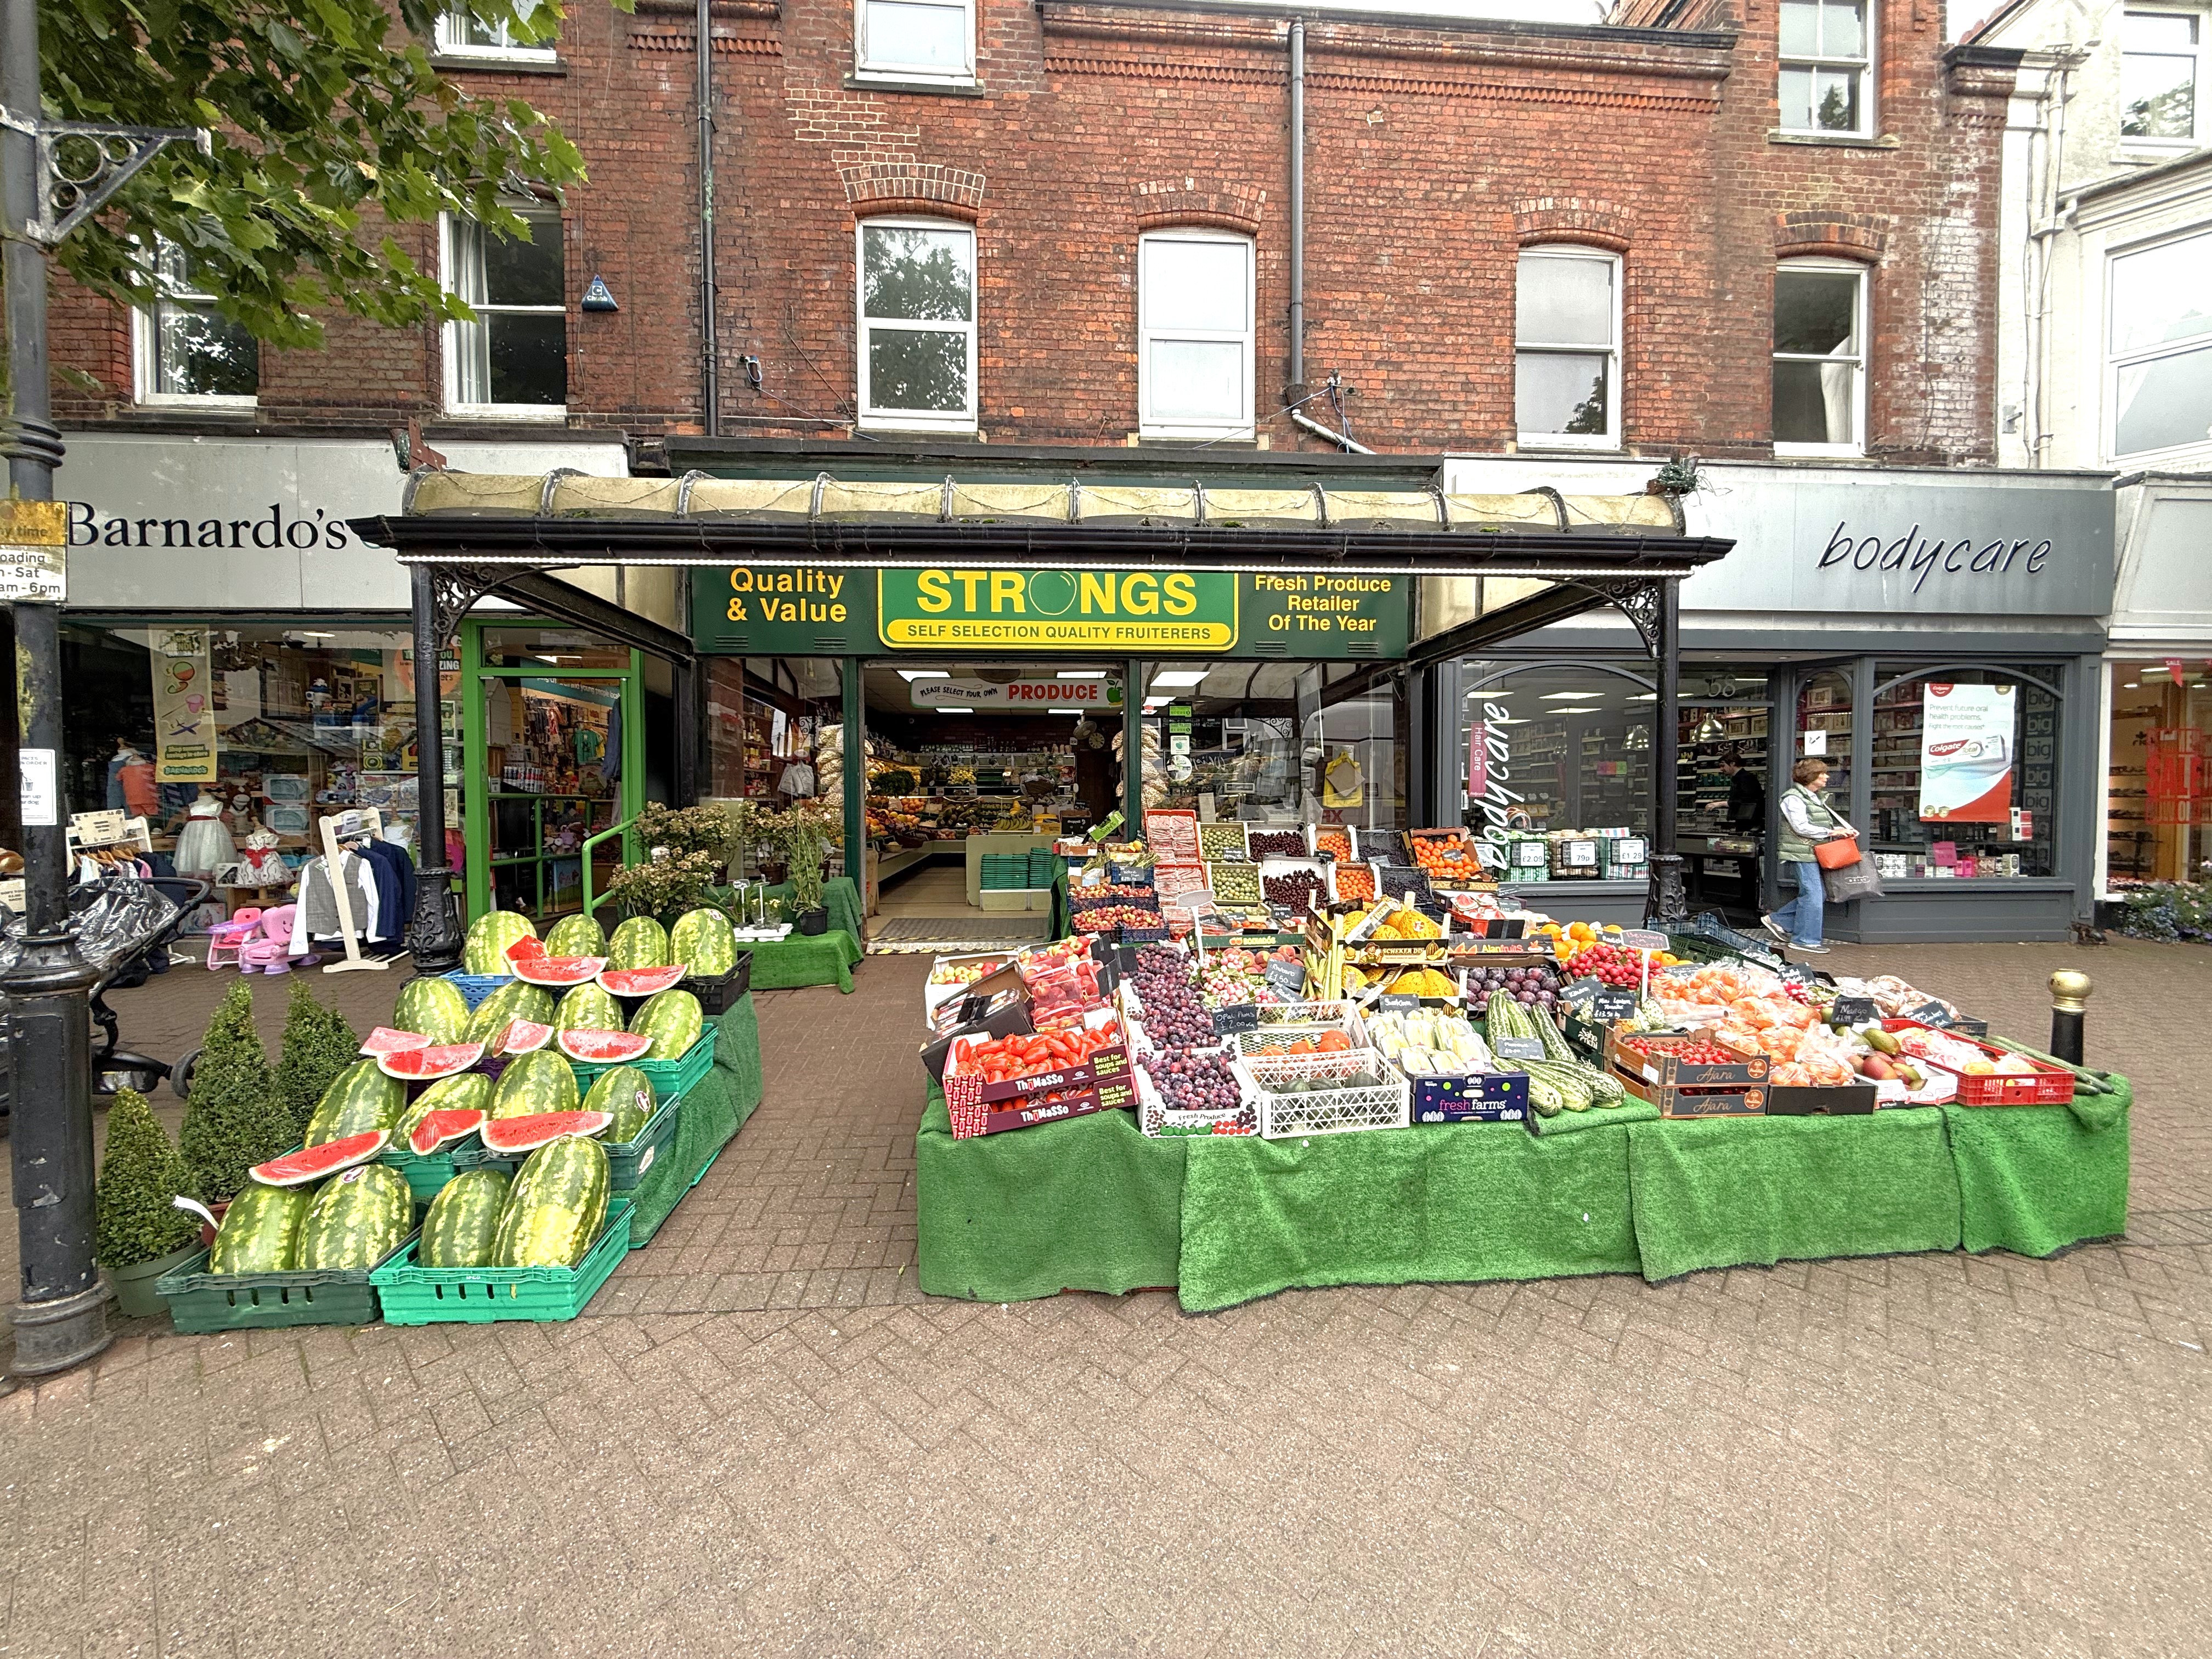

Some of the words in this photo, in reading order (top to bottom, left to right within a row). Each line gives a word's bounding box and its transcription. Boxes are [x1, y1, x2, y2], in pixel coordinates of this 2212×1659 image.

[16, 526, 48, 537] time
[68, 501, 347, 550] Barnardo's
[0, 552, 45, 563] oading
[1815, 520, 2051, 594] bodycare
[15, 567, 40, 578] Sat
[730, 567, 844, 599] Quality
[1255, 574, 1307, 591] Fresh
[1314, 575, 1391, 592] Produce
[727, 597, 748, 621] &
[759, 598, 847, 622] Value
[1288, 595, 1359, 611] Retailer
[1268, 614, 1290, 630] Of
[1296, 614, 1330, 630] The
[1336, 615, 1376, 631] Year
[907, 625, 946, 637] SELF
[952, 625, 1040, 638] SELECTION
[1046, 626, 1110, 639] QUALITY
[1116, 627, 1211, 640] FRUITERERS
[920, 686, 940, 697] PLEASE
[943, 686, 964, 697] SELECT
[984, 687, 997, 697] OWN
[1008, 684, 1098, 701] PRODUCE
[2029, 690, 2053, 707] big
[2029, 715, 2052, 733] big
[1475, 727, 1483, 746] Hair
[1930, 742, 1962, 753] Colgate
[2026, 738, 2051, 759] big
[1474, 749, 1483, 771] Care
[2025, 767, 2051, 786] big
[1474, 702, 1525, 871] bodycare
[2025, 794, 2050, 811] big
[1840, 1005, 1867, 1018] Mango
[1093, 1056, 1110, 1064] Best
[1095, 1061, 1114, 1070] soups
[1115, 1057, 1127, 1066] and
[1096, 1066, 1120, 1076] sauces
[1696, 1066, 1736, 1083] Ajara
[1099, 1086, 1115, 1095] Best
[1100, 1092, 1120, 1101] soups
[1120, 1088, 1133, 1097] and
[1101, 1097, 1125, 1107] sauces
[1693, 1097, 1733, 1114] Ajara
[1178, 1113, 1198, 1121] Fresh
